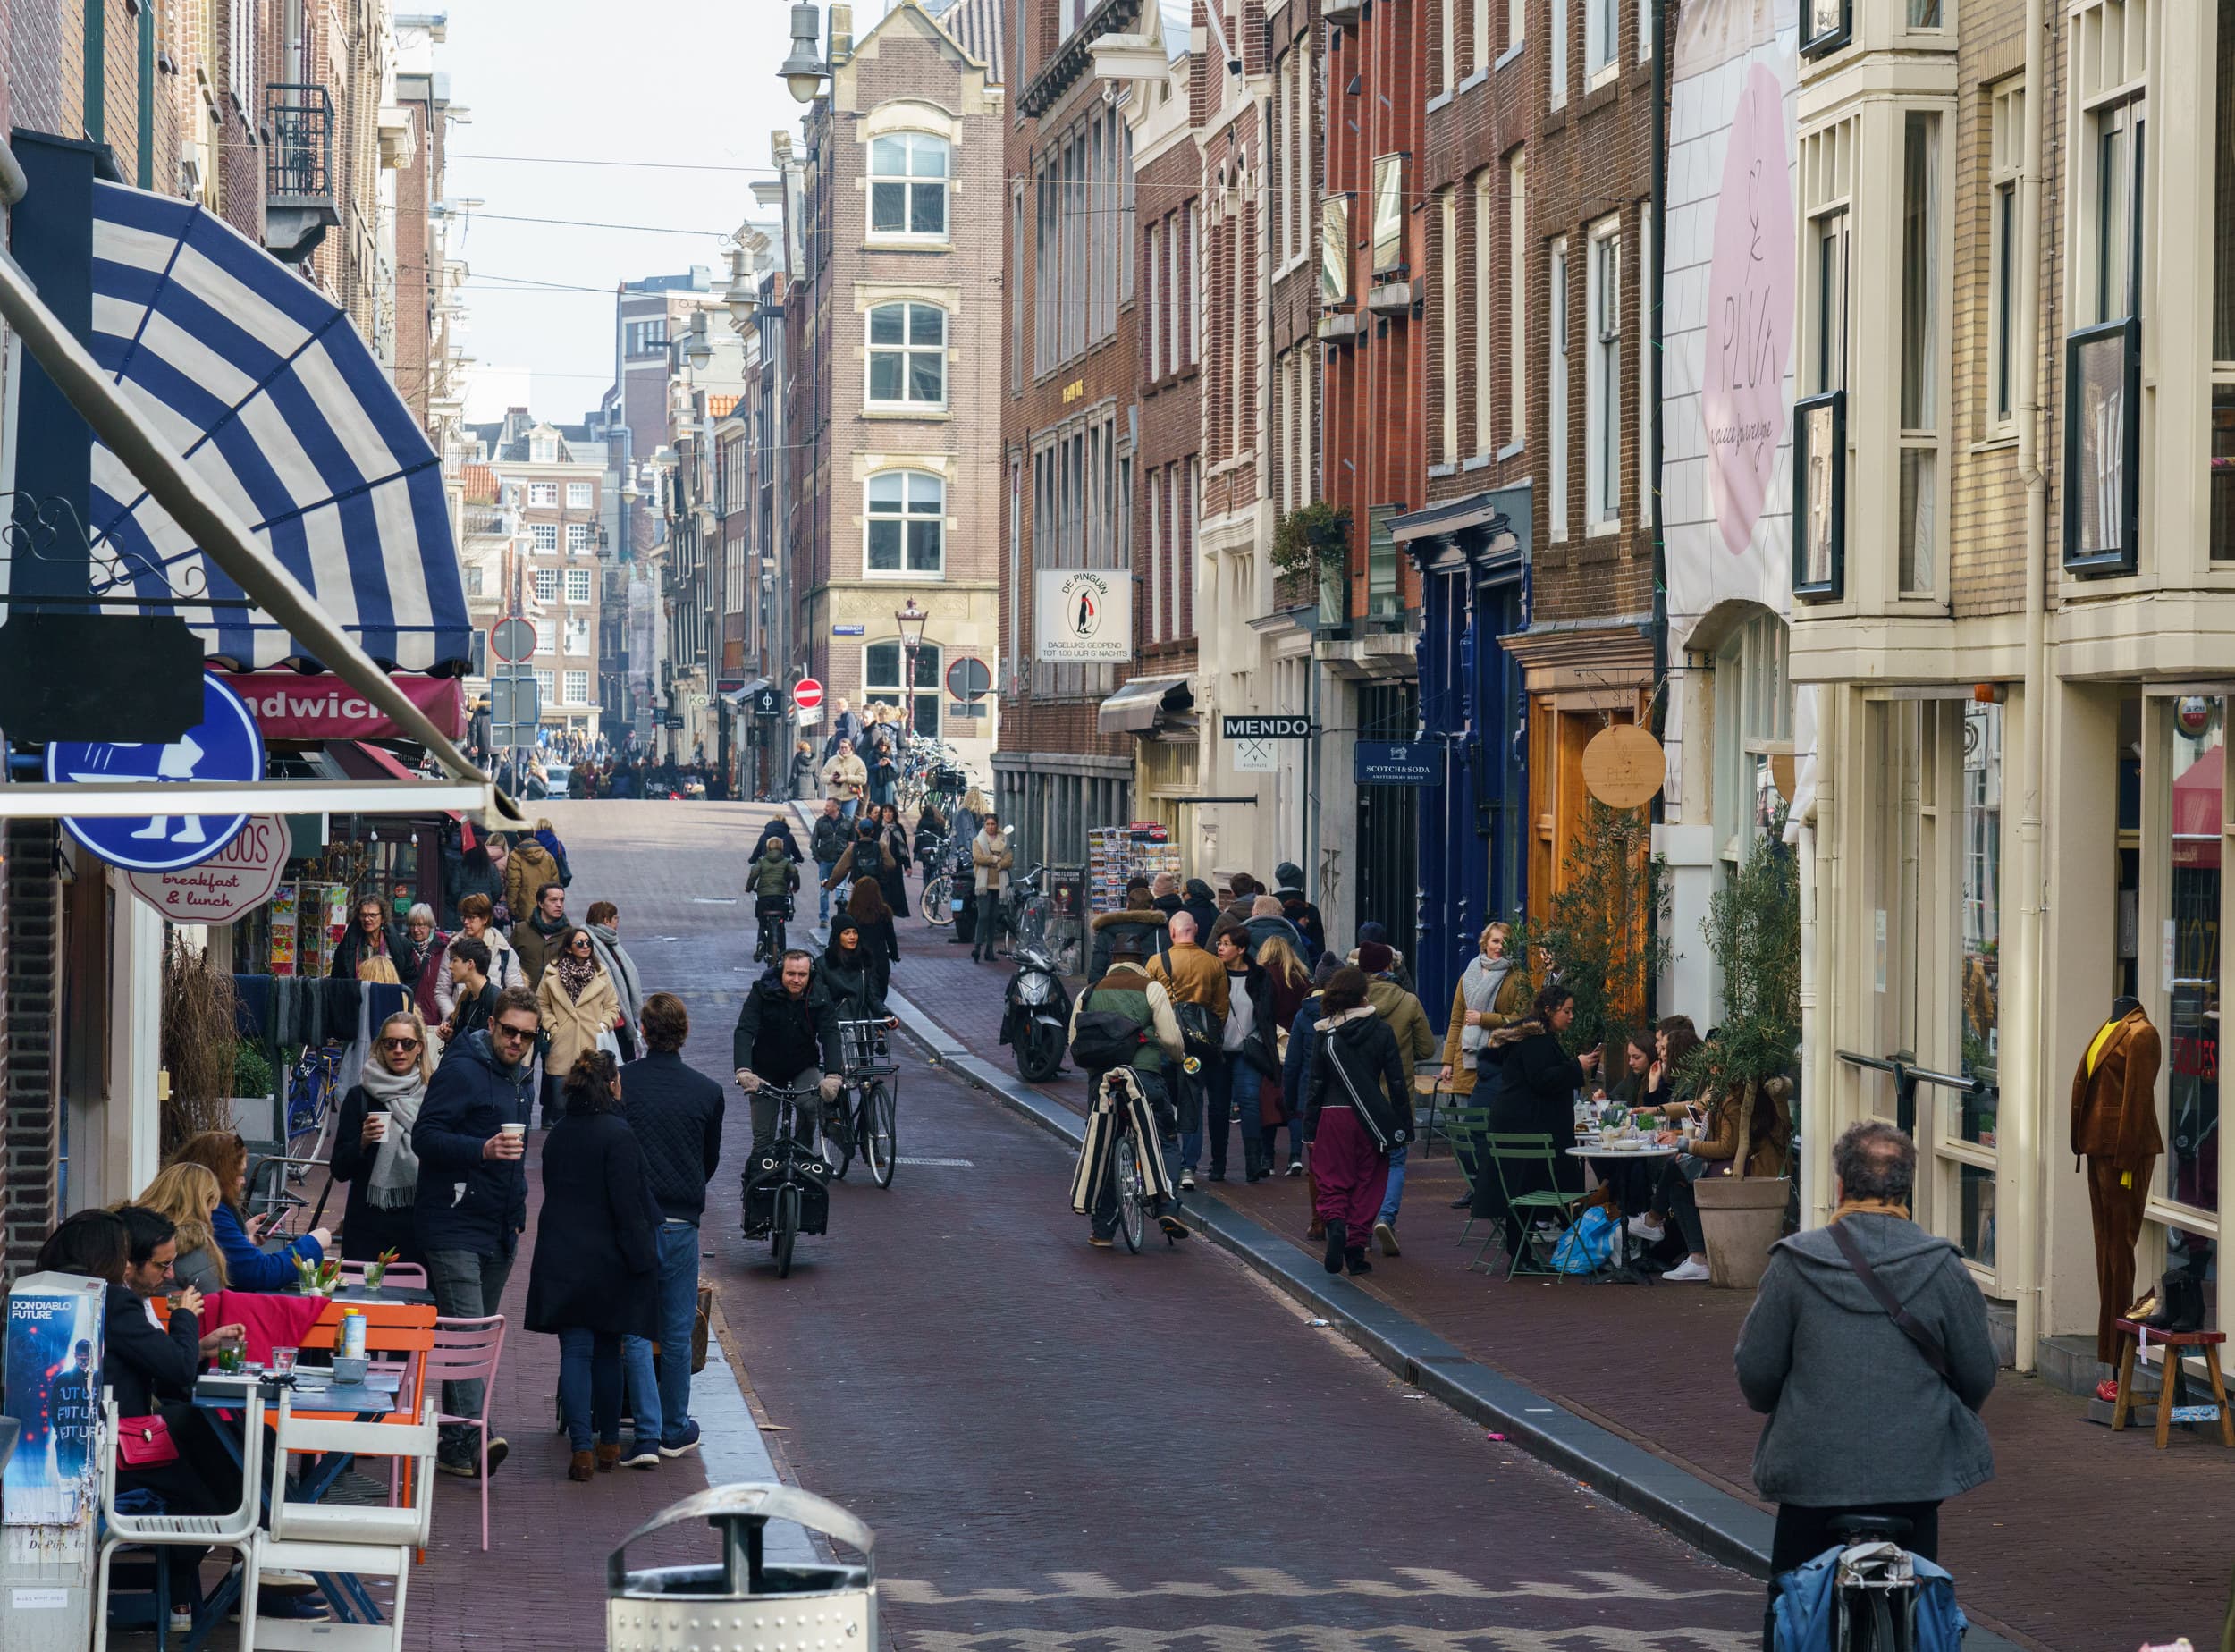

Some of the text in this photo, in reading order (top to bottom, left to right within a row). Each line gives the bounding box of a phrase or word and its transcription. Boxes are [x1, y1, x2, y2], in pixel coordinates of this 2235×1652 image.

[1061, 572, 1109, 595] DE PINGUÏN
[1226, 720, 1309, 735] MENDO
[162, 872, 240, 893] breakfast
[166, 890, 233, 907] & lunch
[12, 1301, 35, 1311] DON
[12, 1311, 53, 1319] FUTURE
